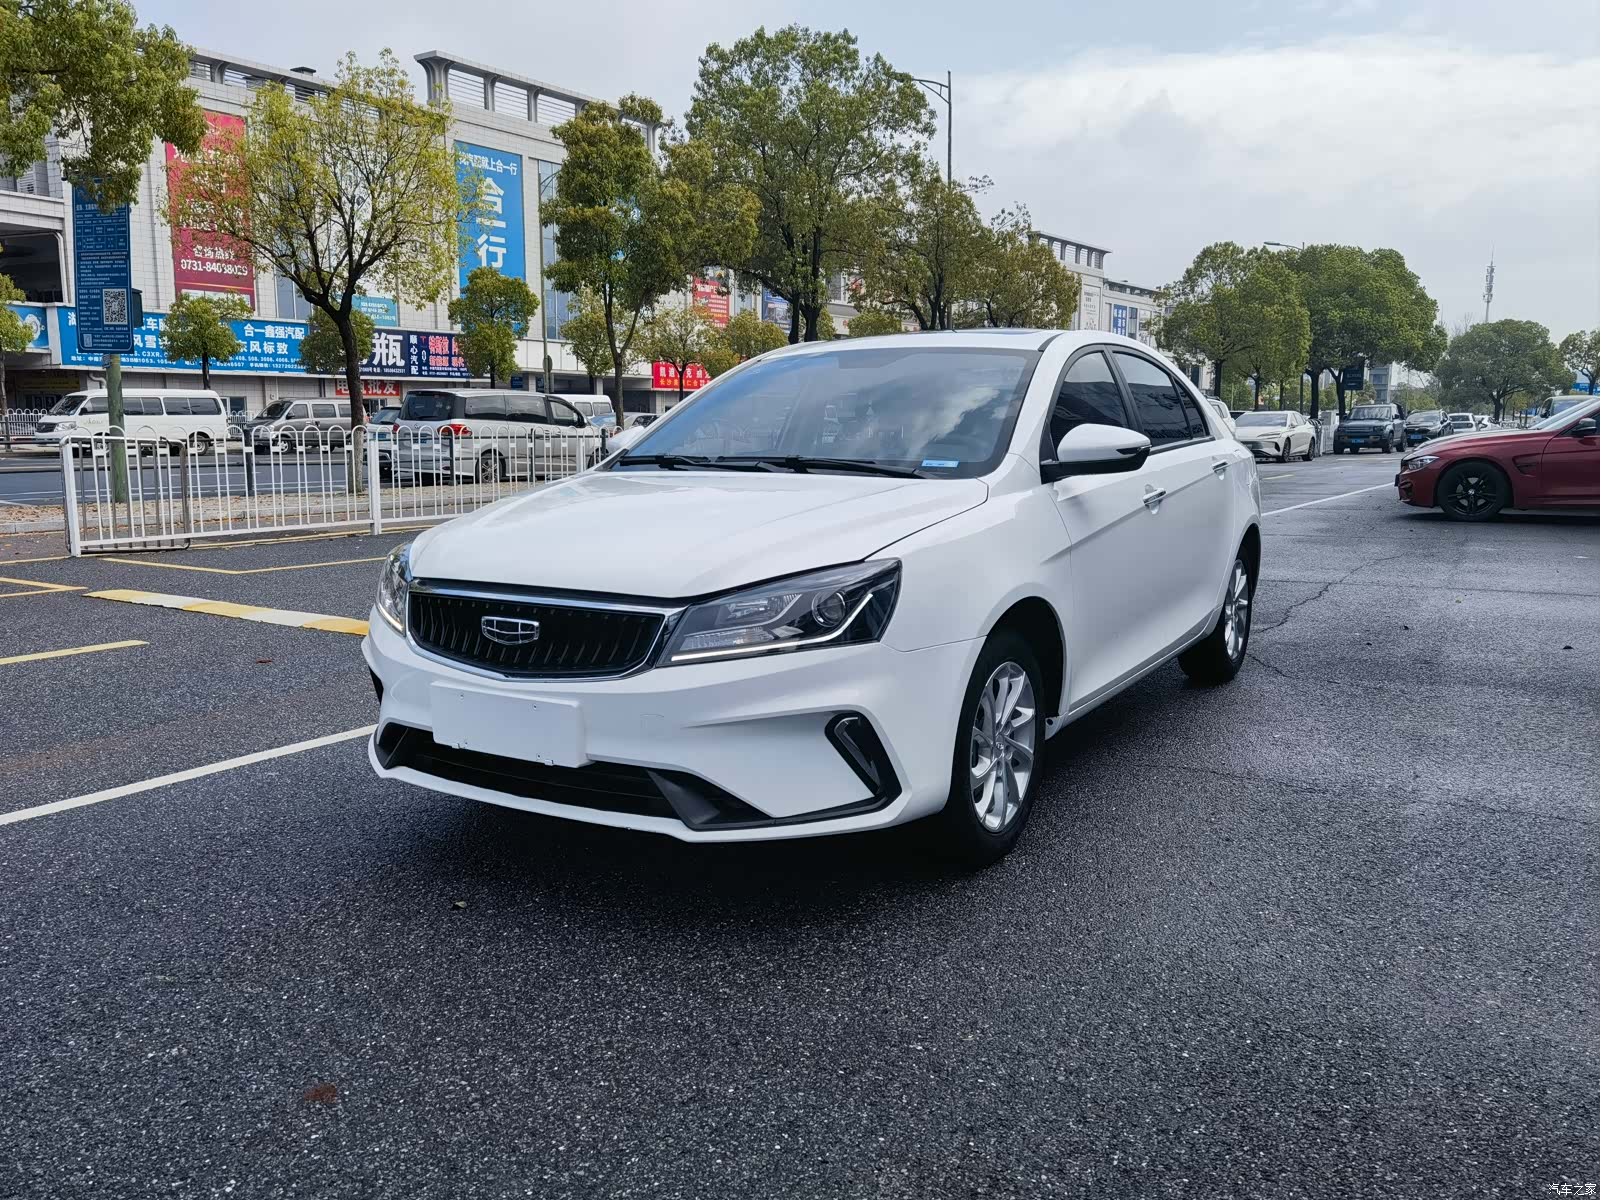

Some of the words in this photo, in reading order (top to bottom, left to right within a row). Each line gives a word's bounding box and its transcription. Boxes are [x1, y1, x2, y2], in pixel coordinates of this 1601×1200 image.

[244, 323, 305, 340] 合一鑫强汽配
